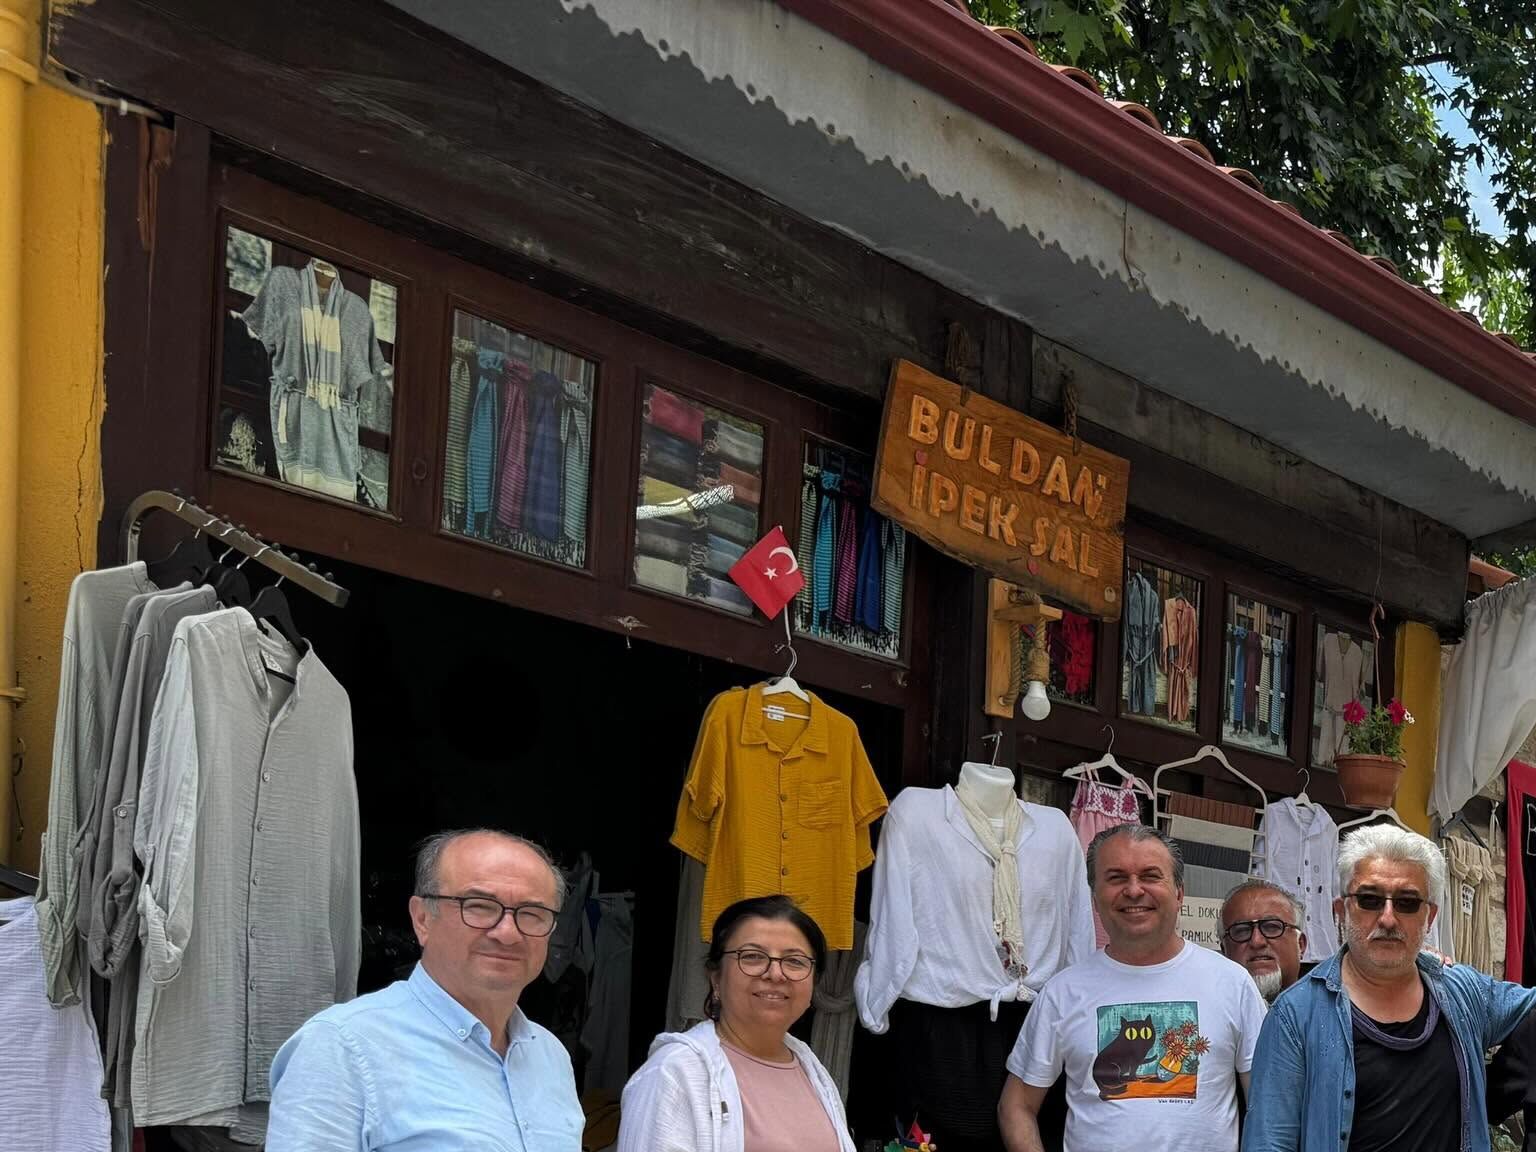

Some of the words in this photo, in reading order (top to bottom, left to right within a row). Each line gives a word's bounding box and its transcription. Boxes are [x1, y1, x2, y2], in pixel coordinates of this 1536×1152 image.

[908, 394, 1103, 520] BULDAN
[1180, 905, 1193, 917] EL
[1181, 929, 1213, 943] PAMUK
